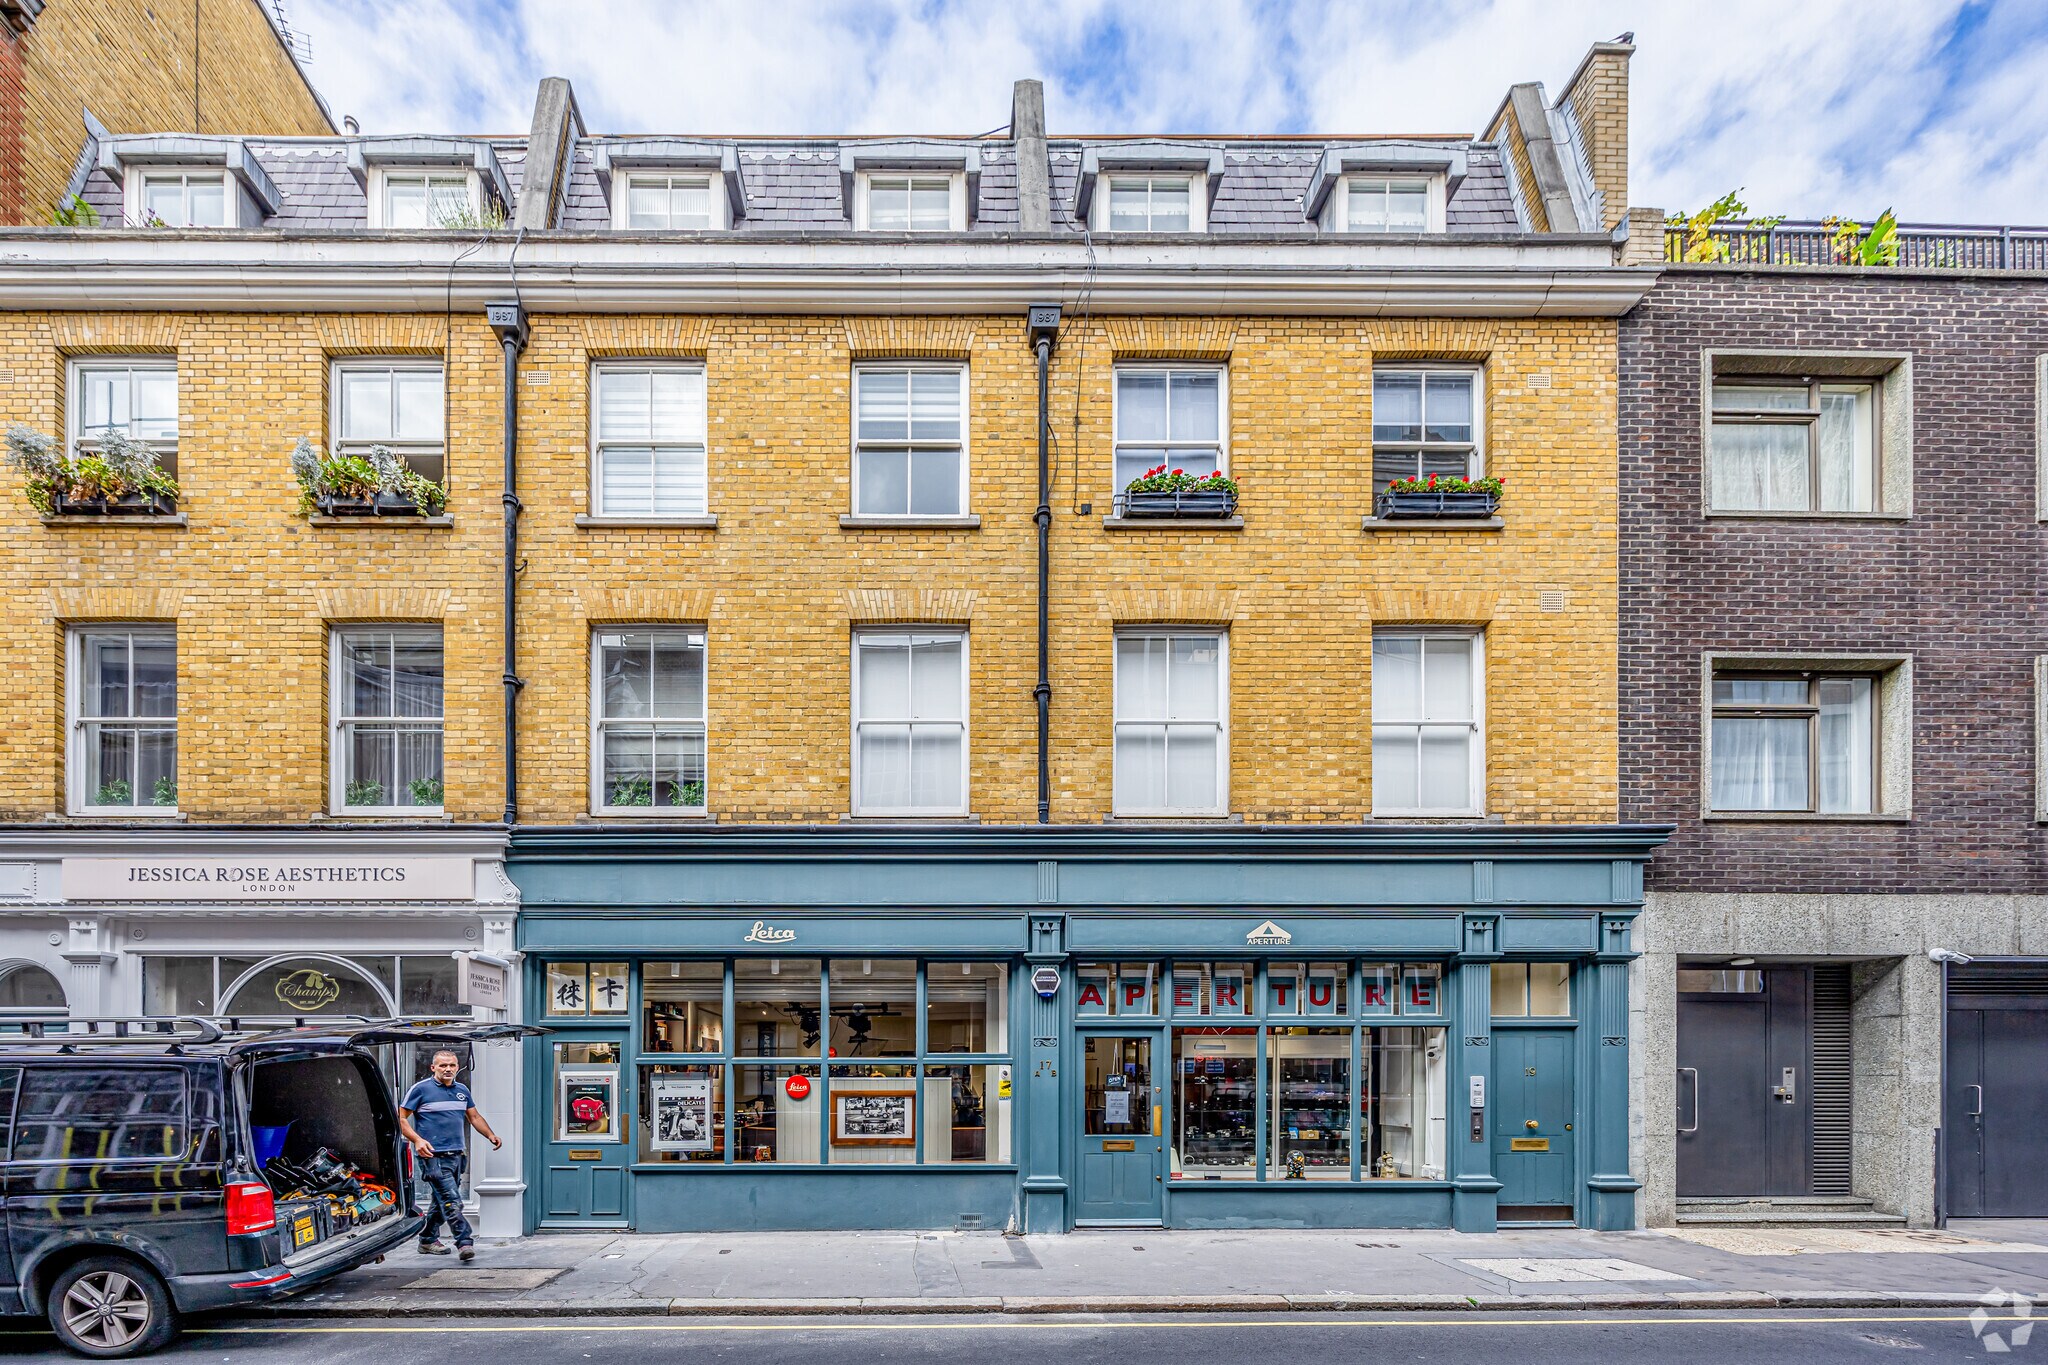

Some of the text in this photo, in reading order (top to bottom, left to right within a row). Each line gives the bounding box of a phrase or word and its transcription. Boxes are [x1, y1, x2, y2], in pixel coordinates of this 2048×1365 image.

[492, 311, 513, 322] 1987
[1035, 312, 1057, 323] 1987
[128, 867, 406, 882] JESSICA ROSE AESTHETICS
[242, 884, 296, 892] LONDON
[743, 920, 797, 943] Leica
[1246, 937, 1291, 945] APERTURE
[470, 973, 501, 986] JESSICA ROSE
[472, 981, 501, 992] AESTHETICS
[1078, 984, 1431, 1007] APERTURE
[1040, 1060, 1052, 1070] 17
[1525, 1066, 1537, 1077] 19
[787, 1082, 808, 1092] Leica
